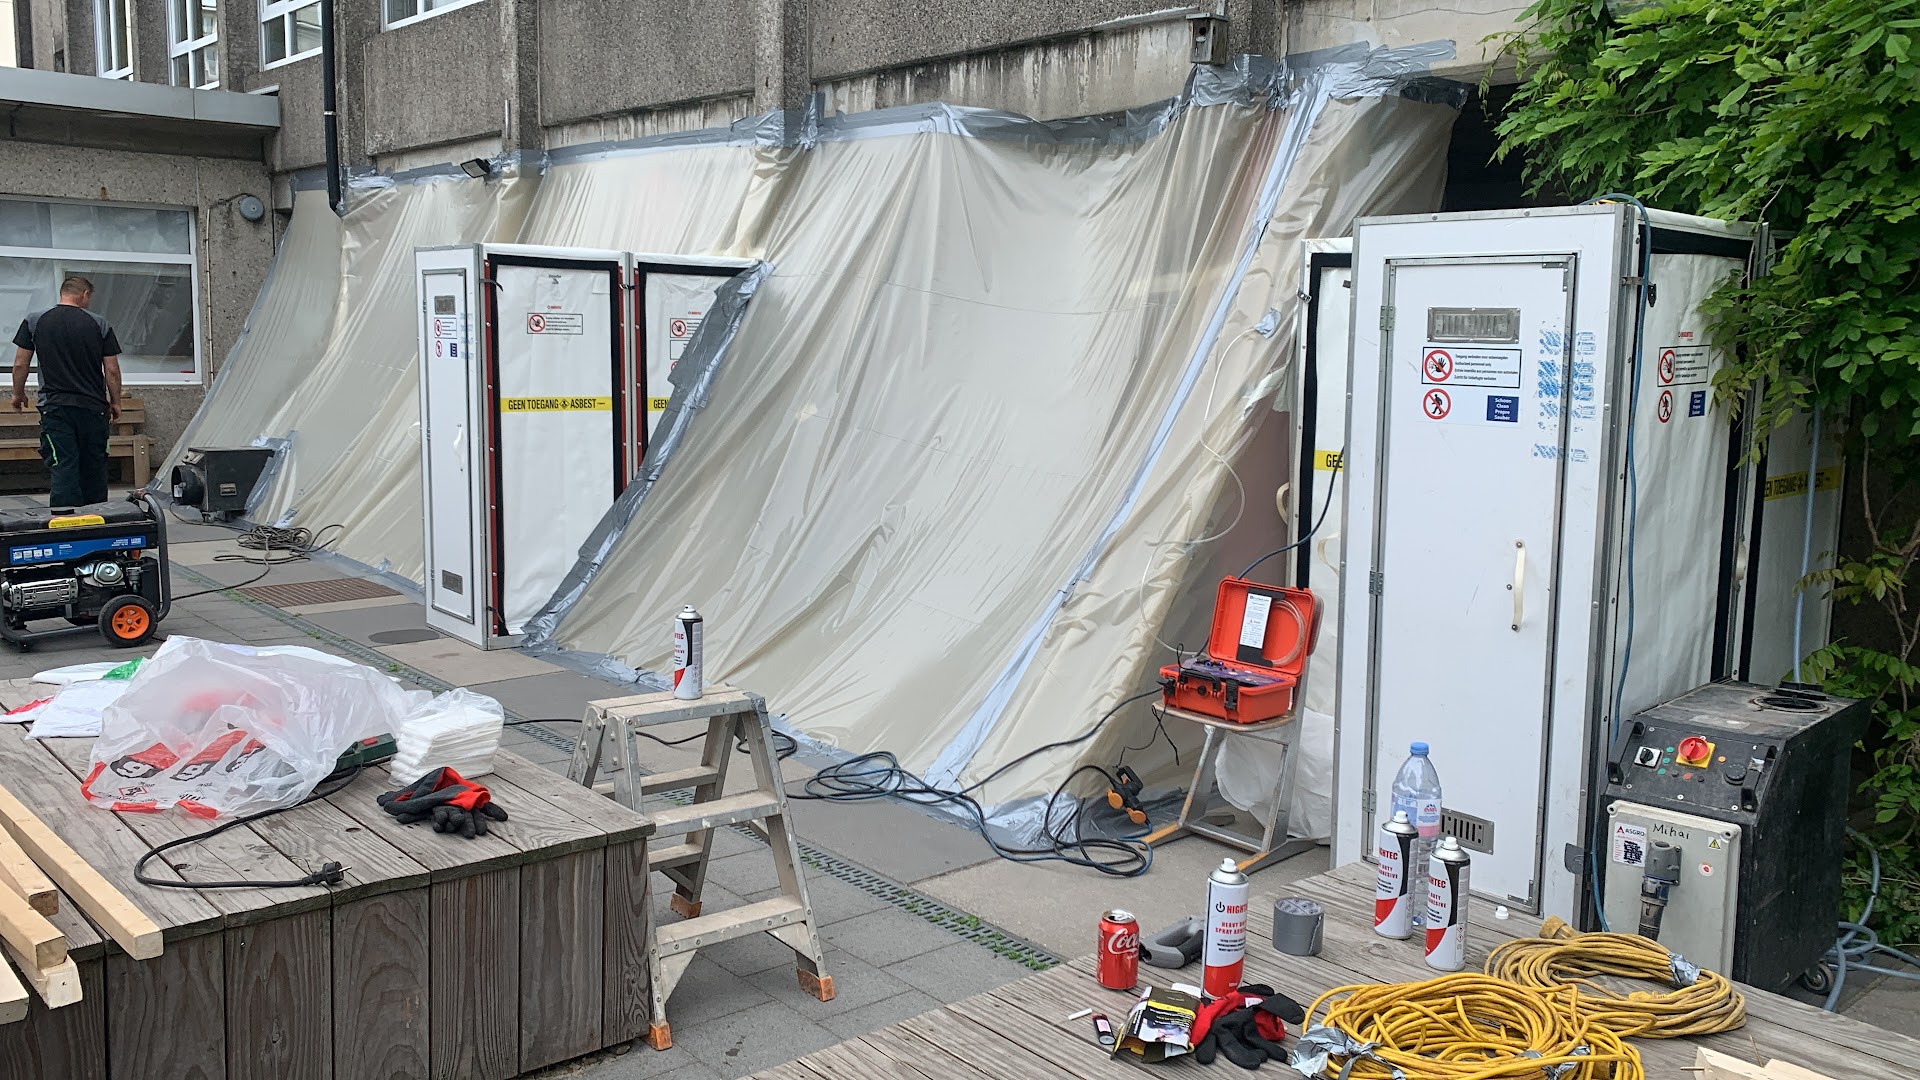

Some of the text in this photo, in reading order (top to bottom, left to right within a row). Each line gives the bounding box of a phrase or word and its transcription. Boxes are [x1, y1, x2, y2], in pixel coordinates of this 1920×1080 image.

[508, 398, 597, 410] GEEN TOEGANG ASBEST
[1325, 453, 1343, 469] GEE
[1625, 829, 1645, 837] ASGRO
[1653, 823, 1691, 840] Mihai
